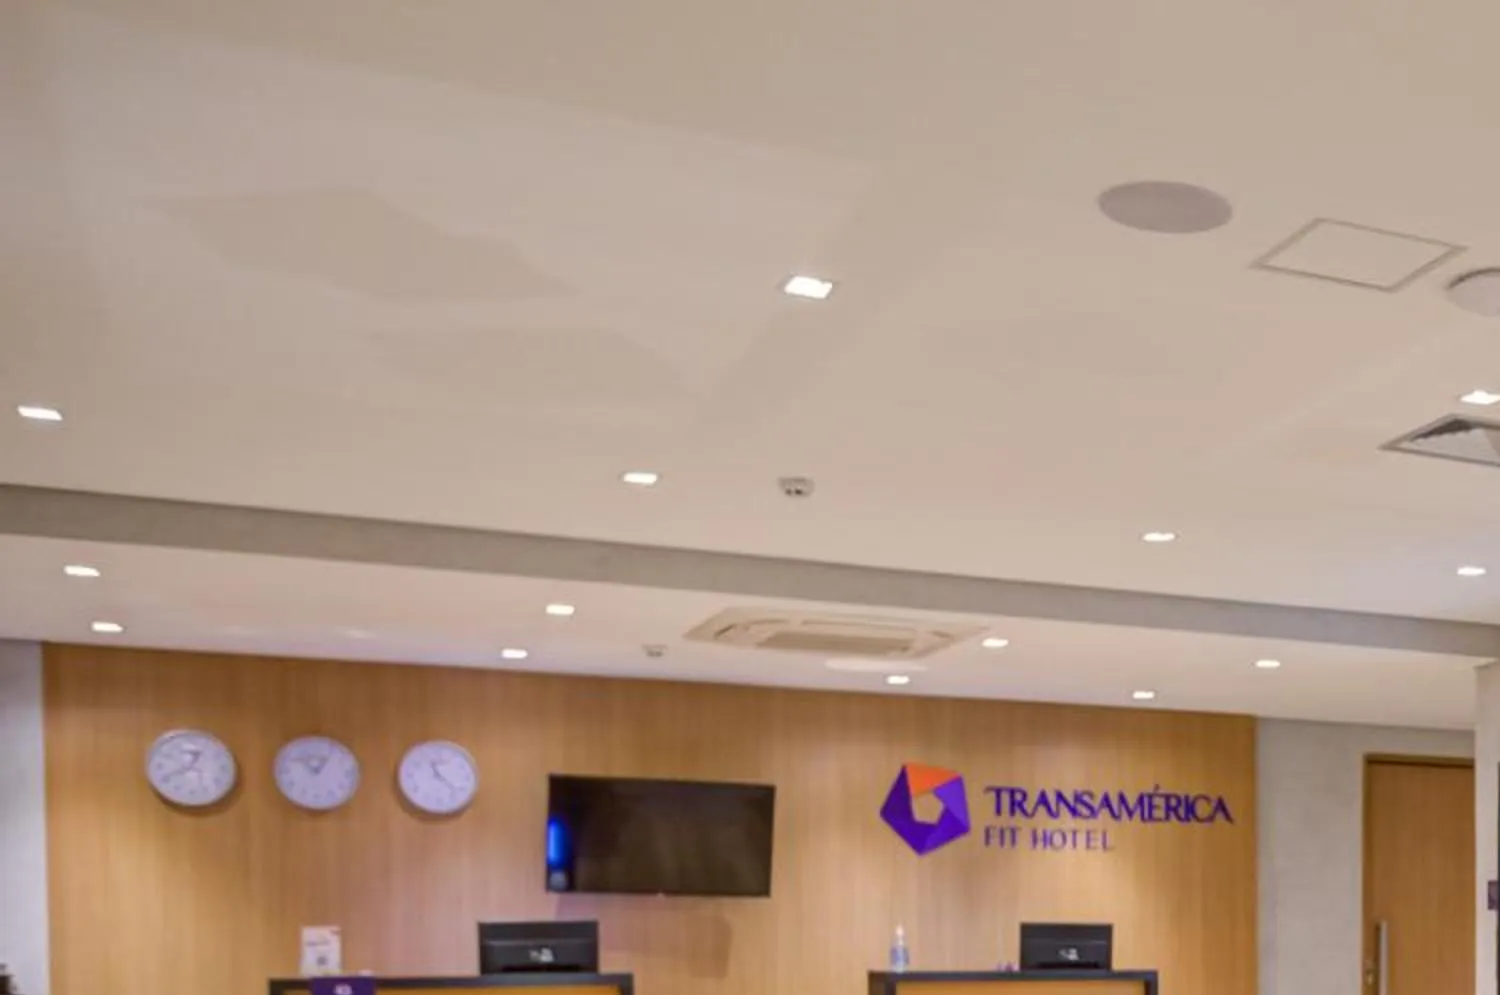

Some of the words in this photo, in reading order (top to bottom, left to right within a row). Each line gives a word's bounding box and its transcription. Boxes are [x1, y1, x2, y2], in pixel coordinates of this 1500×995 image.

[984, 784, 1234, 824] TRANSAMÉRICA
[984, 825, 1020, 849] FIT
[1031, 827, 1114, 851] HOTEL
